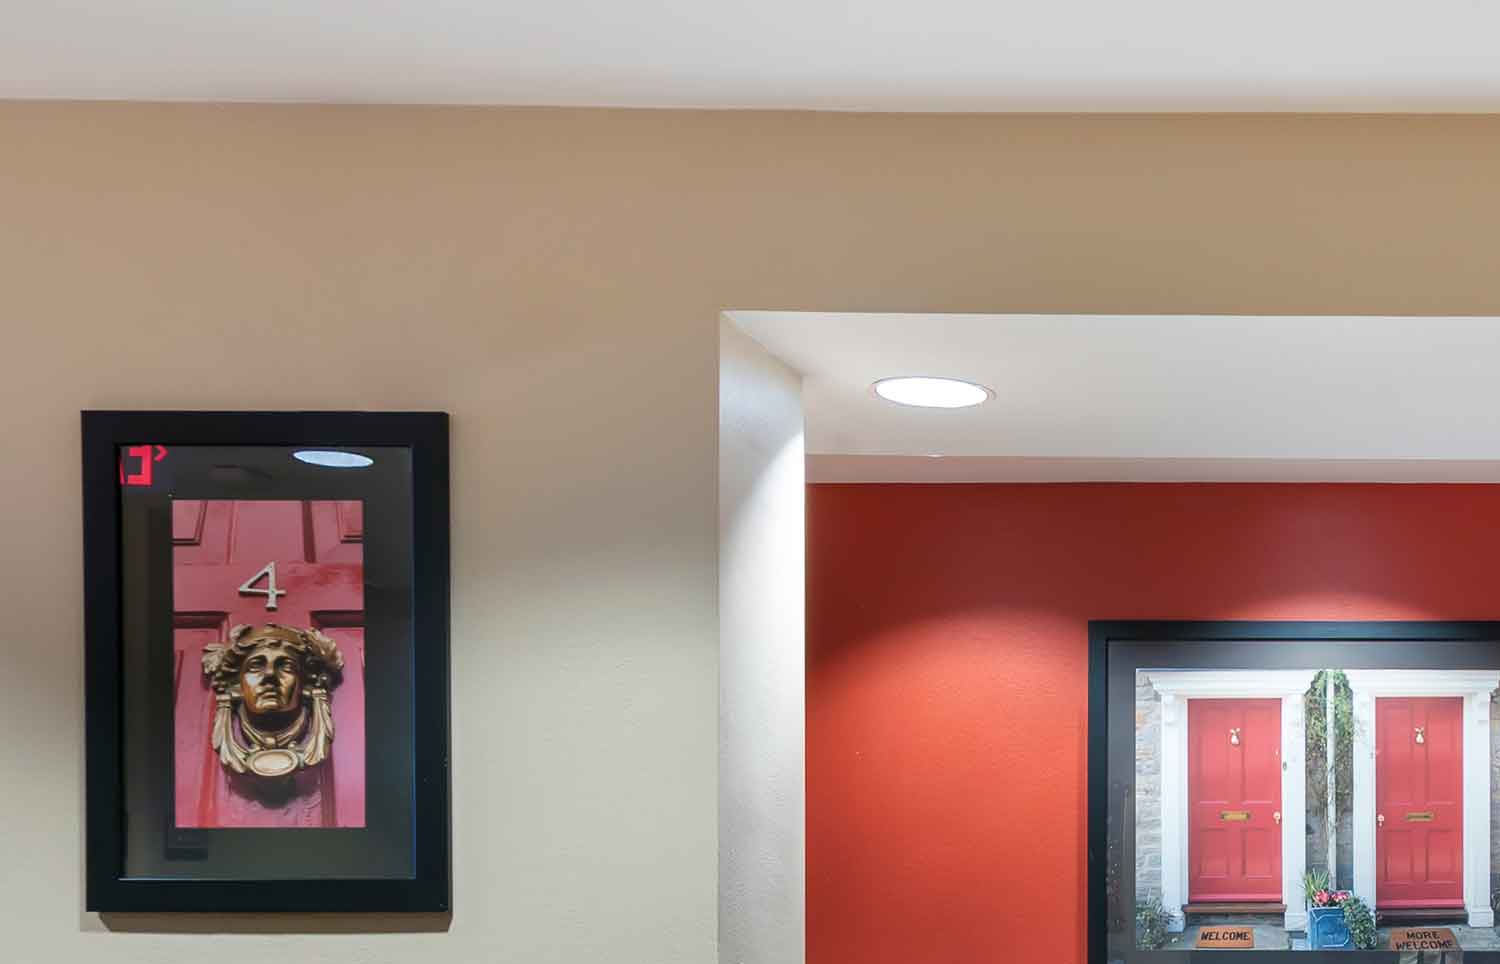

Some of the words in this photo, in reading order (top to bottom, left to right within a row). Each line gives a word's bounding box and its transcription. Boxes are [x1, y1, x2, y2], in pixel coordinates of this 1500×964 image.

[238, 561, 287, 611] 4
[1200, 931, 1249, 941] WELCOME
[1406, 930, 1441, 940] MORE
